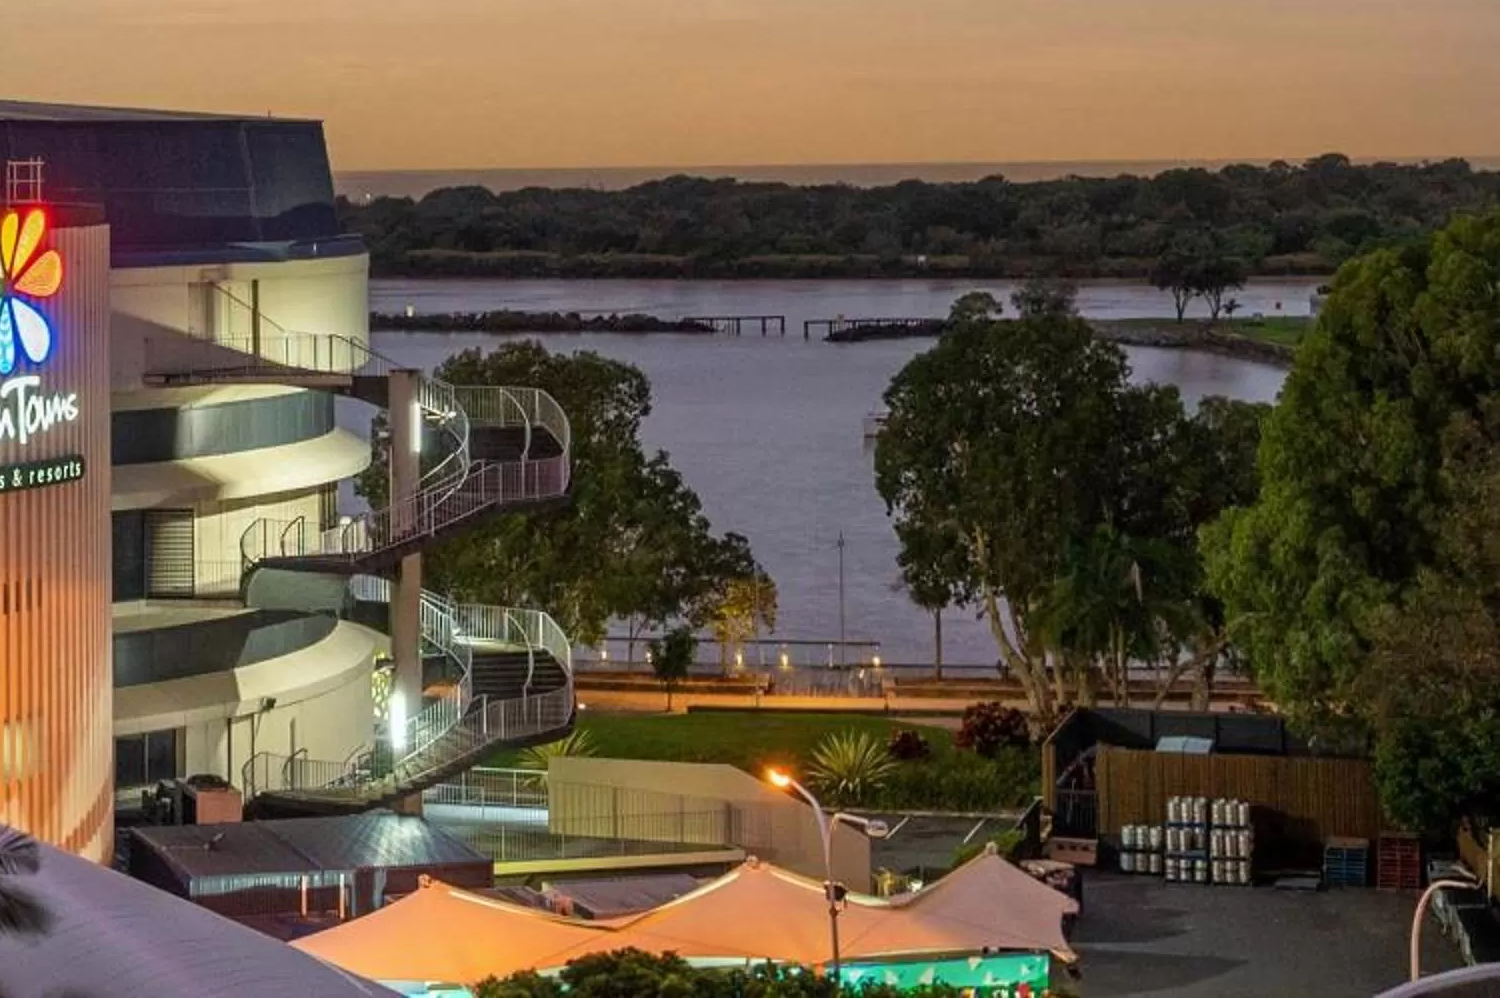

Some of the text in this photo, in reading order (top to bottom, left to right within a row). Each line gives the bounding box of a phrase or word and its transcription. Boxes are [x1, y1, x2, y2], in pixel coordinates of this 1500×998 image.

[0, 375, 79, 445] Towns
[11, 467, 23, 488] &
[28, 460, 82, 485] resorts
